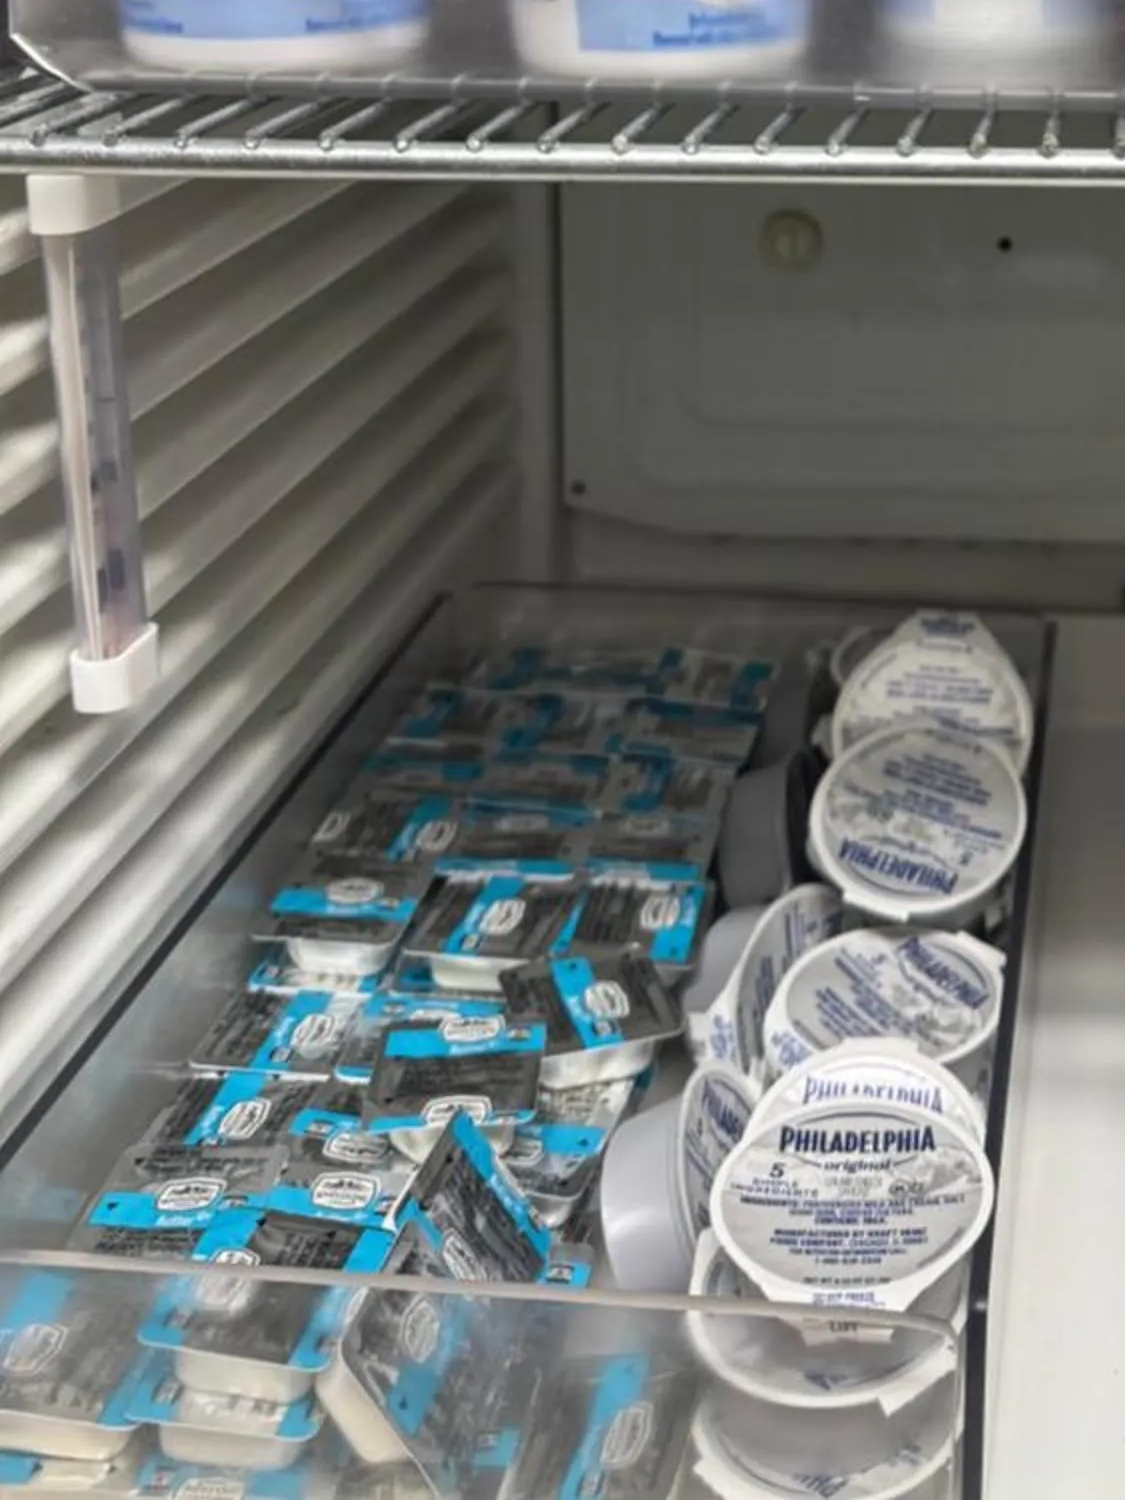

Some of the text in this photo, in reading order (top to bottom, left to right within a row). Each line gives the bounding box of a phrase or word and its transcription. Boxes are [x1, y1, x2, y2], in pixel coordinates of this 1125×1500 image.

[779, 1125, 937, 1154] PHILADELPHIA
[768, 1161, 787, 1179] 5
[823, 1159, 894, 1175] original
